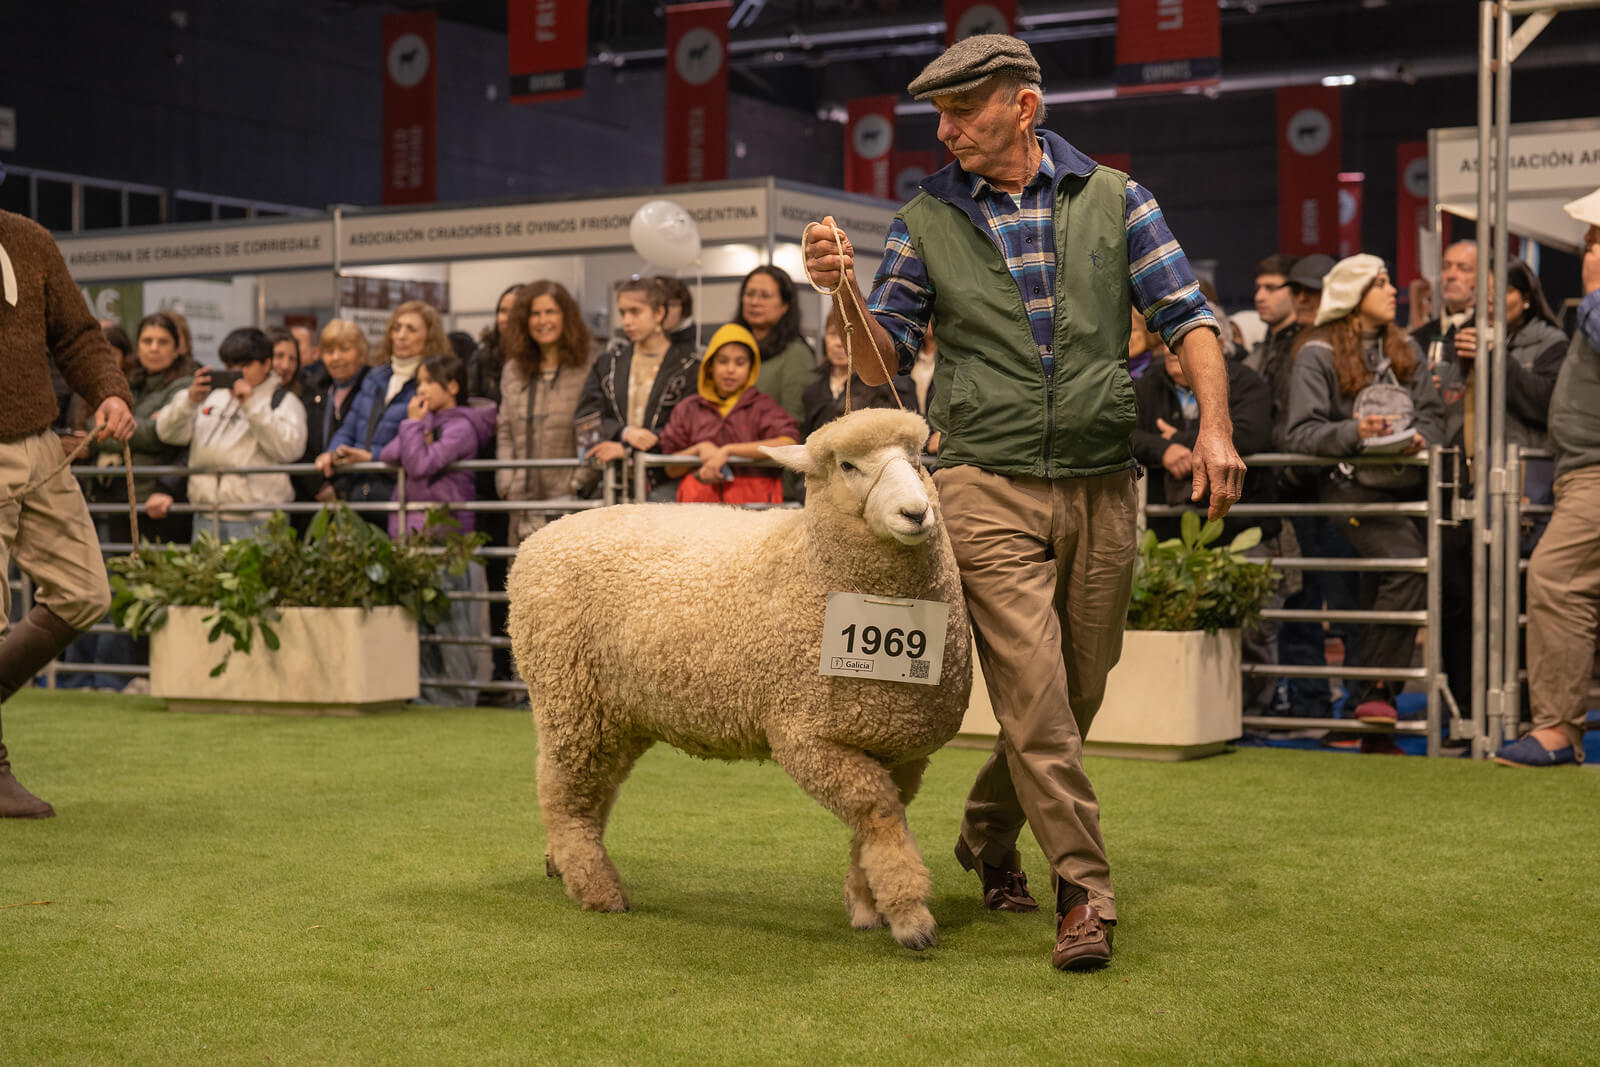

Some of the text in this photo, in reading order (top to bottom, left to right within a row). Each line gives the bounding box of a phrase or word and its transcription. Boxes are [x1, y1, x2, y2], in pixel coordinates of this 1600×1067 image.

[350, 227, 425, 246] ASOCIACIÓN
[427, 223, 501, 242] CRIADORES
[505, 221, 521, 236] DE
[526, 218, 577, 235] OVINOS
[70, 236, 321, 266] ARGENTINA DE CRIADORES DE CORRIEDALE
[841, 623, 927, 660] 1969
[845, 660, 870, 670] Galicia
